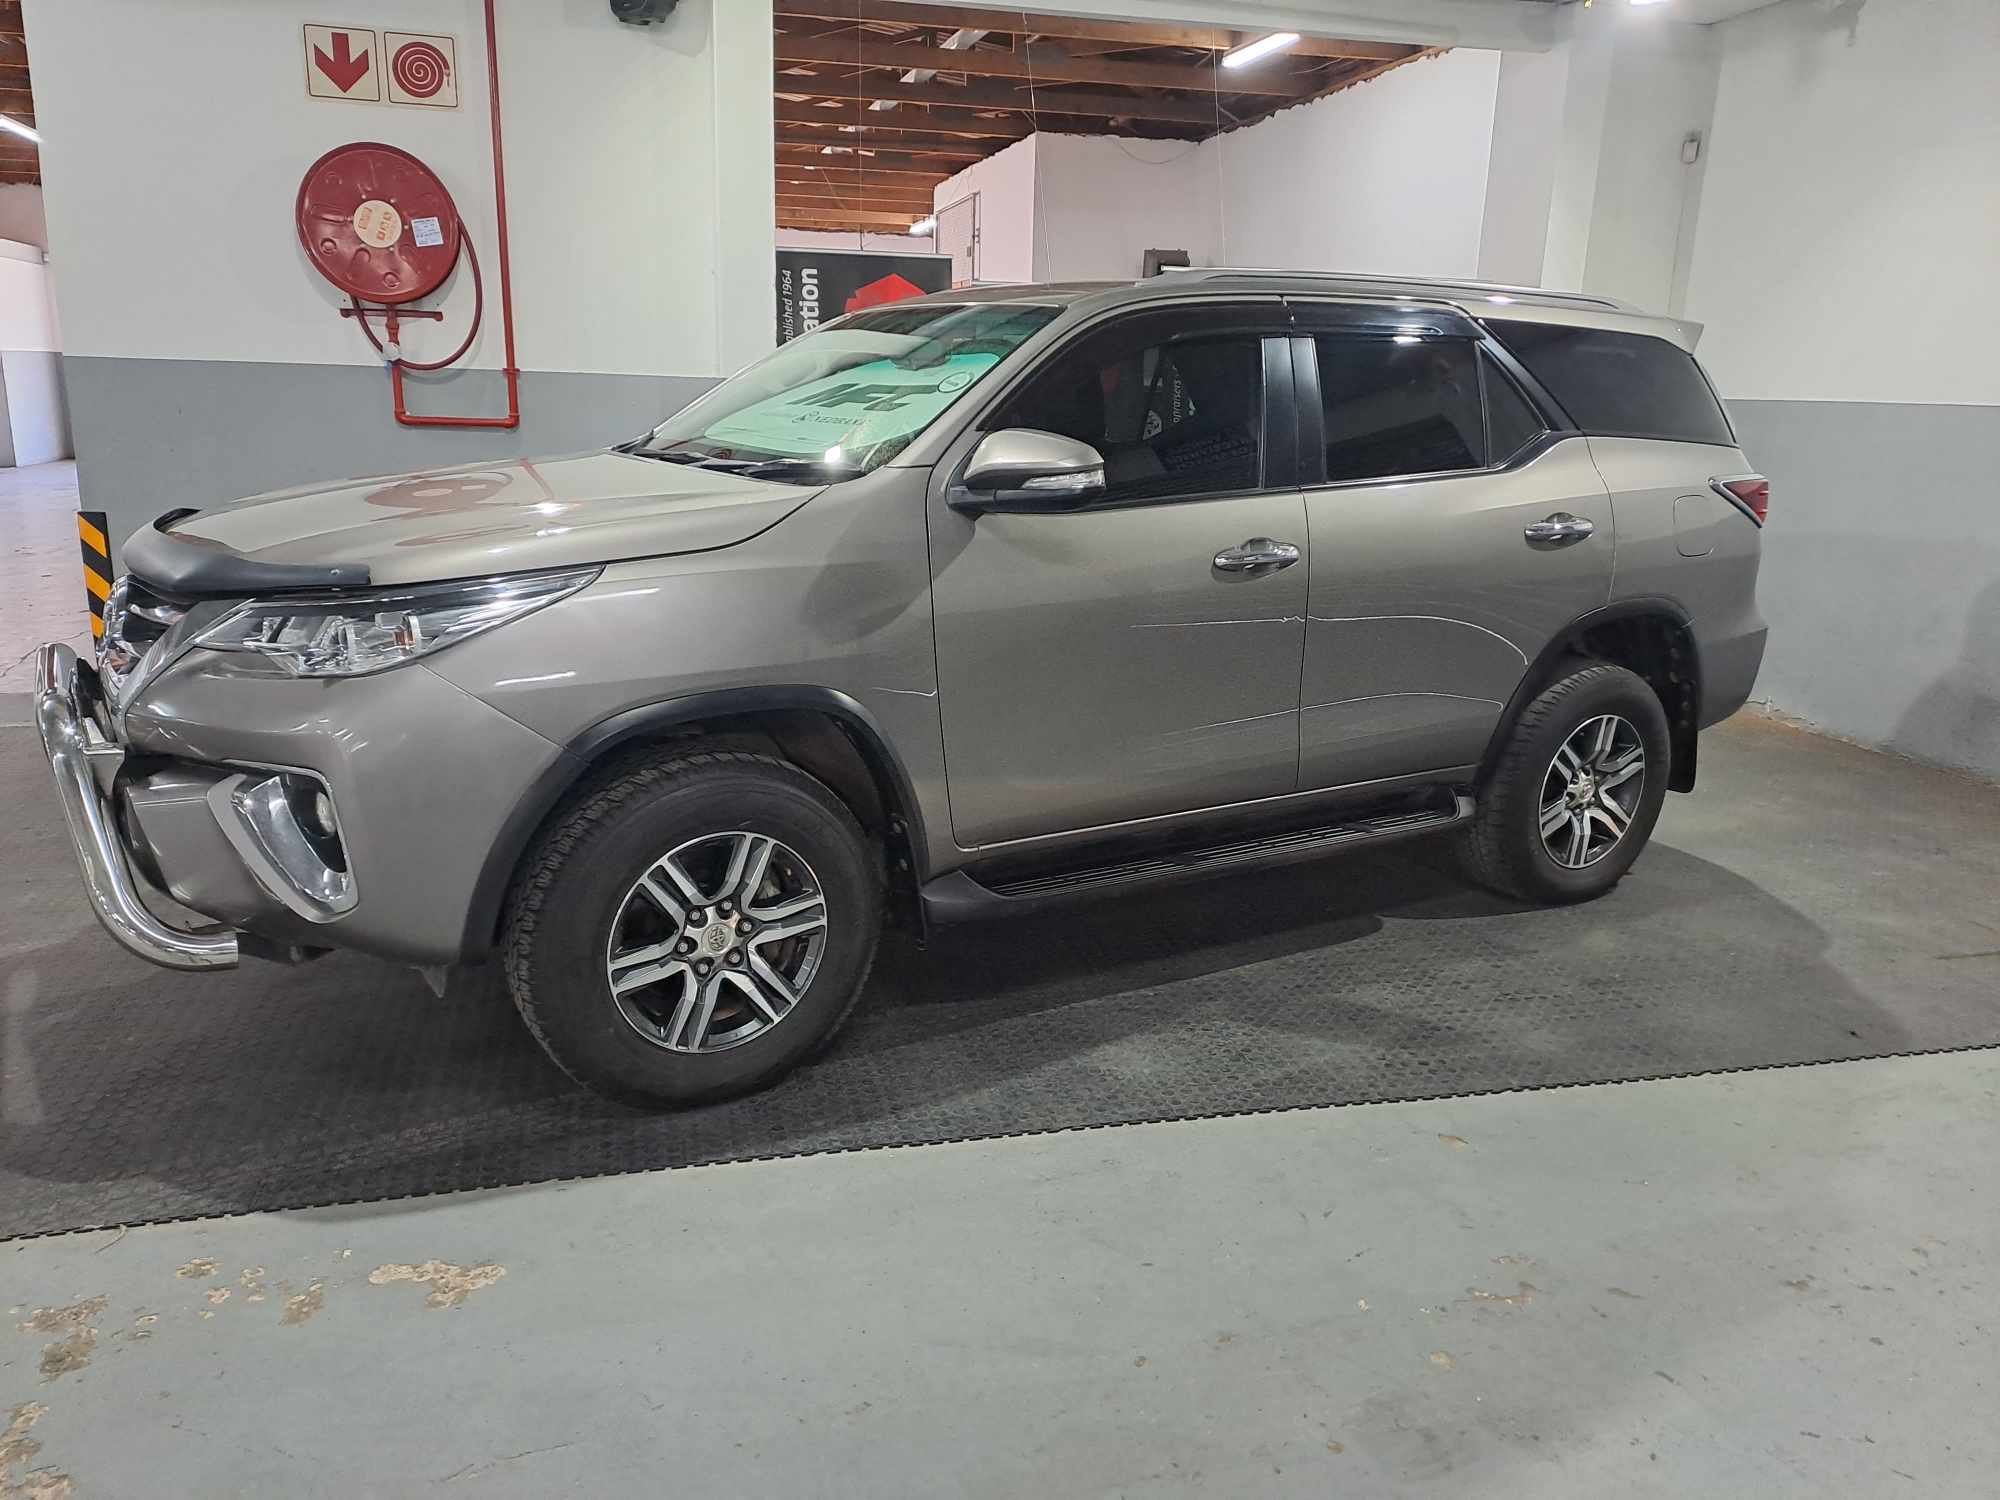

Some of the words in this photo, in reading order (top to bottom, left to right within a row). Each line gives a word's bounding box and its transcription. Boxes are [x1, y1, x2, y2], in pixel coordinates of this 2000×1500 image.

[782, 269, 793, 296] 1964
[799, 268, 820, 332] ation
[782, 298, 794, 342] ablished
